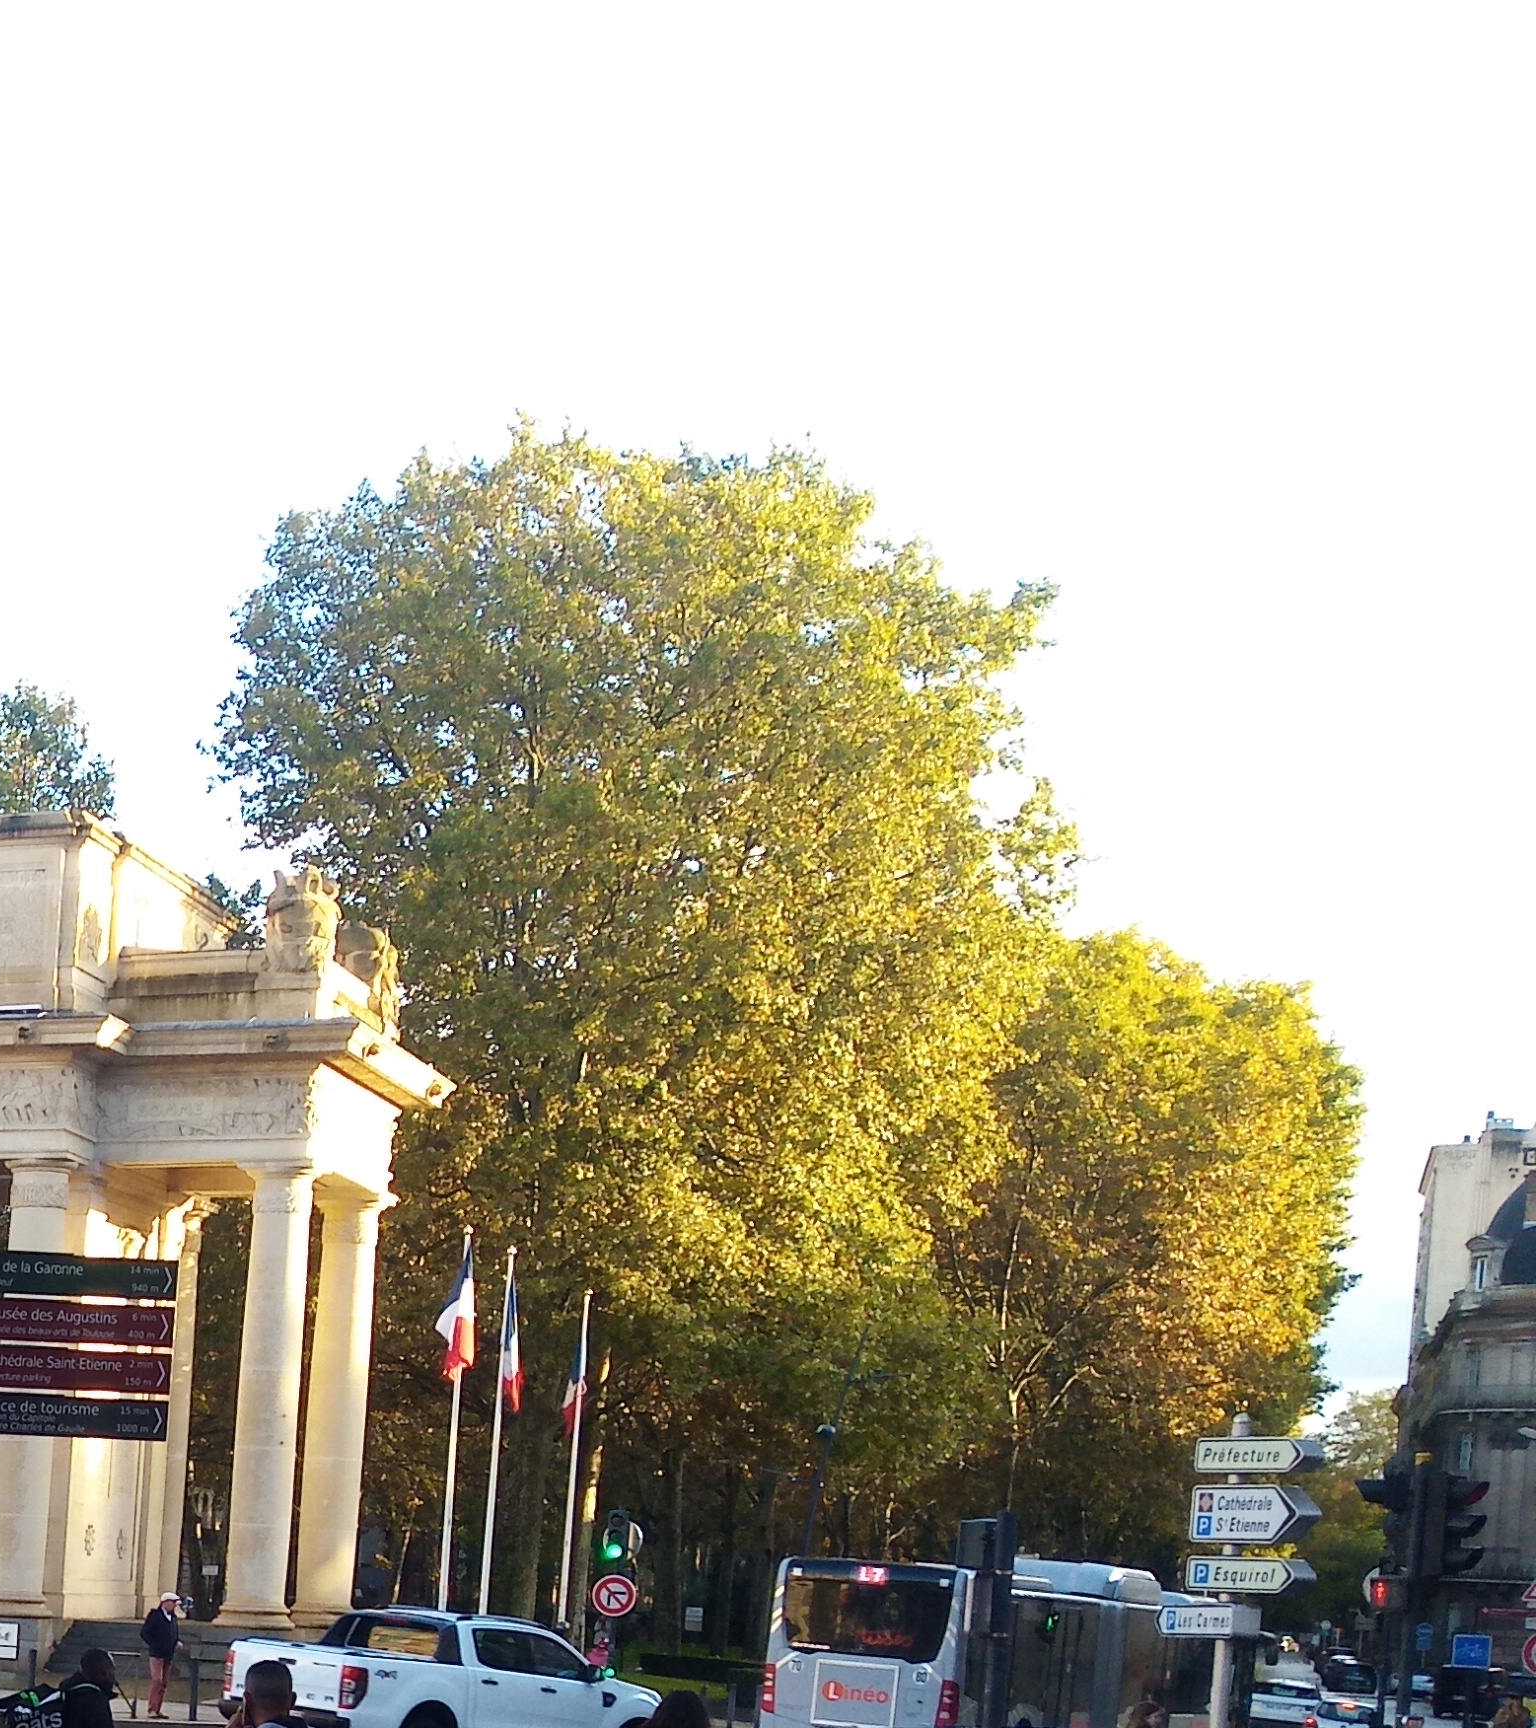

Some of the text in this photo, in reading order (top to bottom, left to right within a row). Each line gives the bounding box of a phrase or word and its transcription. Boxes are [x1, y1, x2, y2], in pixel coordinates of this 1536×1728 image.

[3, 1260, 17, 1273] de
[21, 1260, 30, 1274] la
[34, 1261, 84, 1277] Garonne
[131, 1266, 160, 1275] 14 min
[150, 1285, 159, 1293] m
[31, 1308, 53, 1322] des
[57, 1309, 118, 1327] Augustins
[46, 1354, 123, 1373] Saint-Etienne
[20, 1401, 37, 1414] de
[40, 1402, 100, 1417] tourisme
[1202, 1447, 1281, 1463] Préfecture
[1217, 1495, 1272, 1512] Cathédrale
[1229, 1518, 1270, 1533] Etienne
[1213, 1566, 1276, 1585] Esquirol
[1178, 1613, 1192, 1628] Les
[1196, 1612, 1230, 1628] Carmes
[823, 1680, 890, 1704] Linéo
